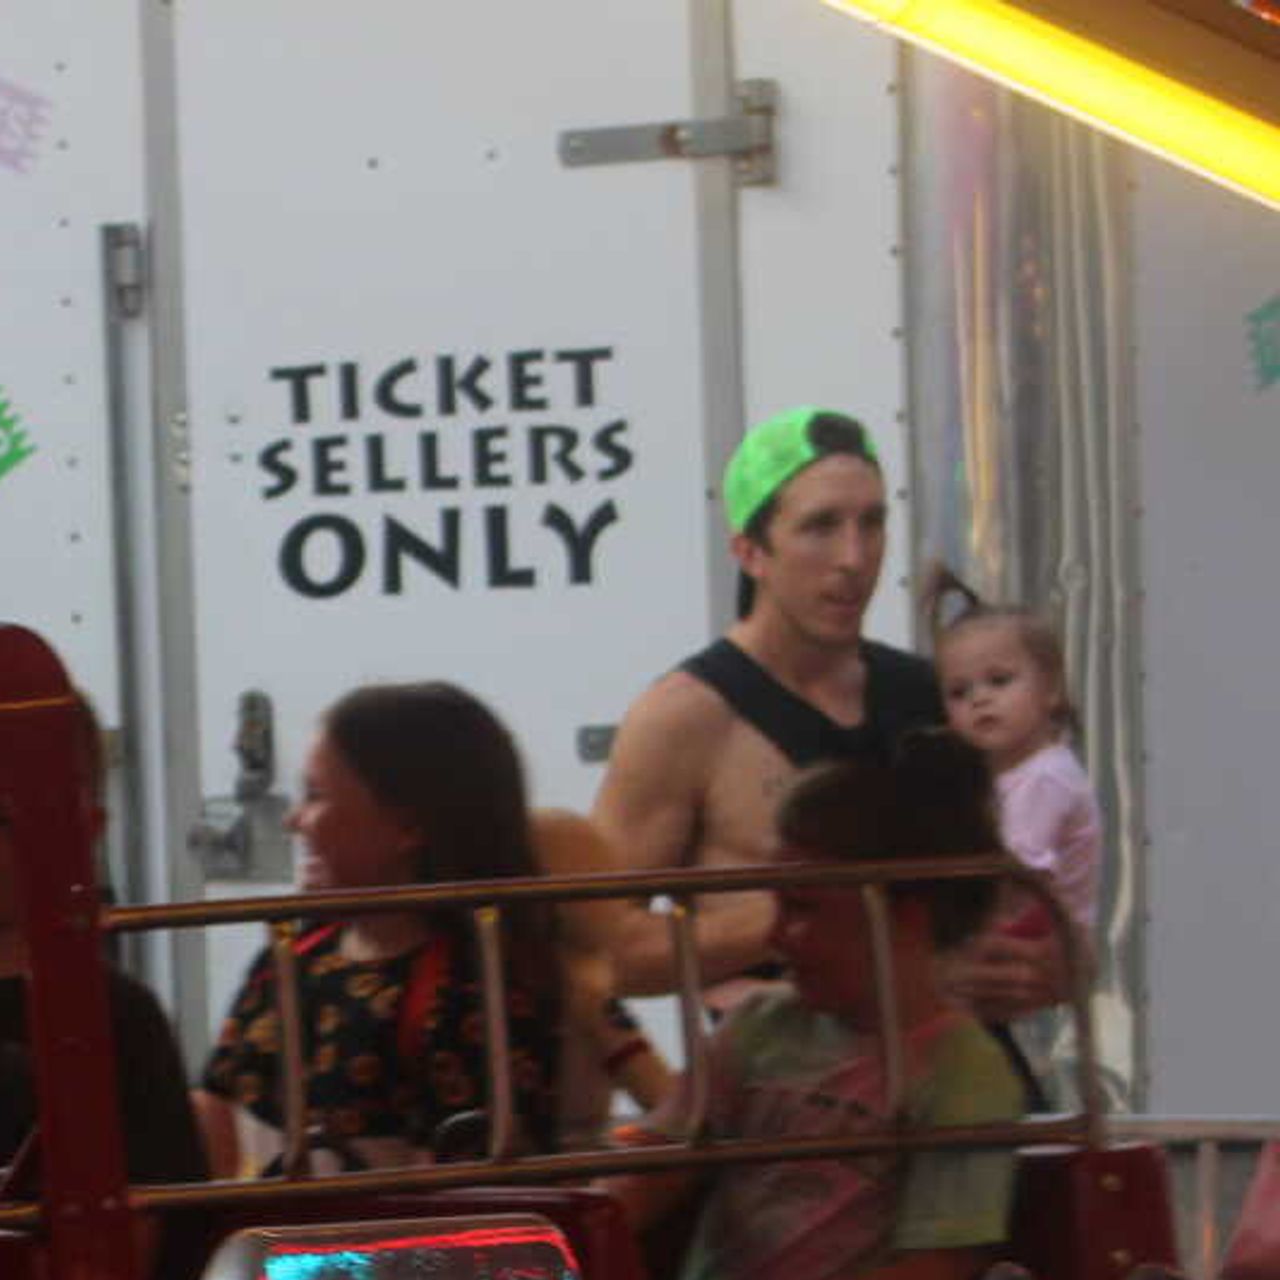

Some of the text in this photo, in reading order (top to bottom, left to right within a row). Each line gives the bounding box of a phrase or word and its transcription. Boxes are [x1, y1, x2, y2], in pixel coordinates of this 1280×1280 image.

[268, 346, 613, 424] TICKET
[256, 419, 633, 500] SELLERS
[277, 498, 620, 599] ONLY
